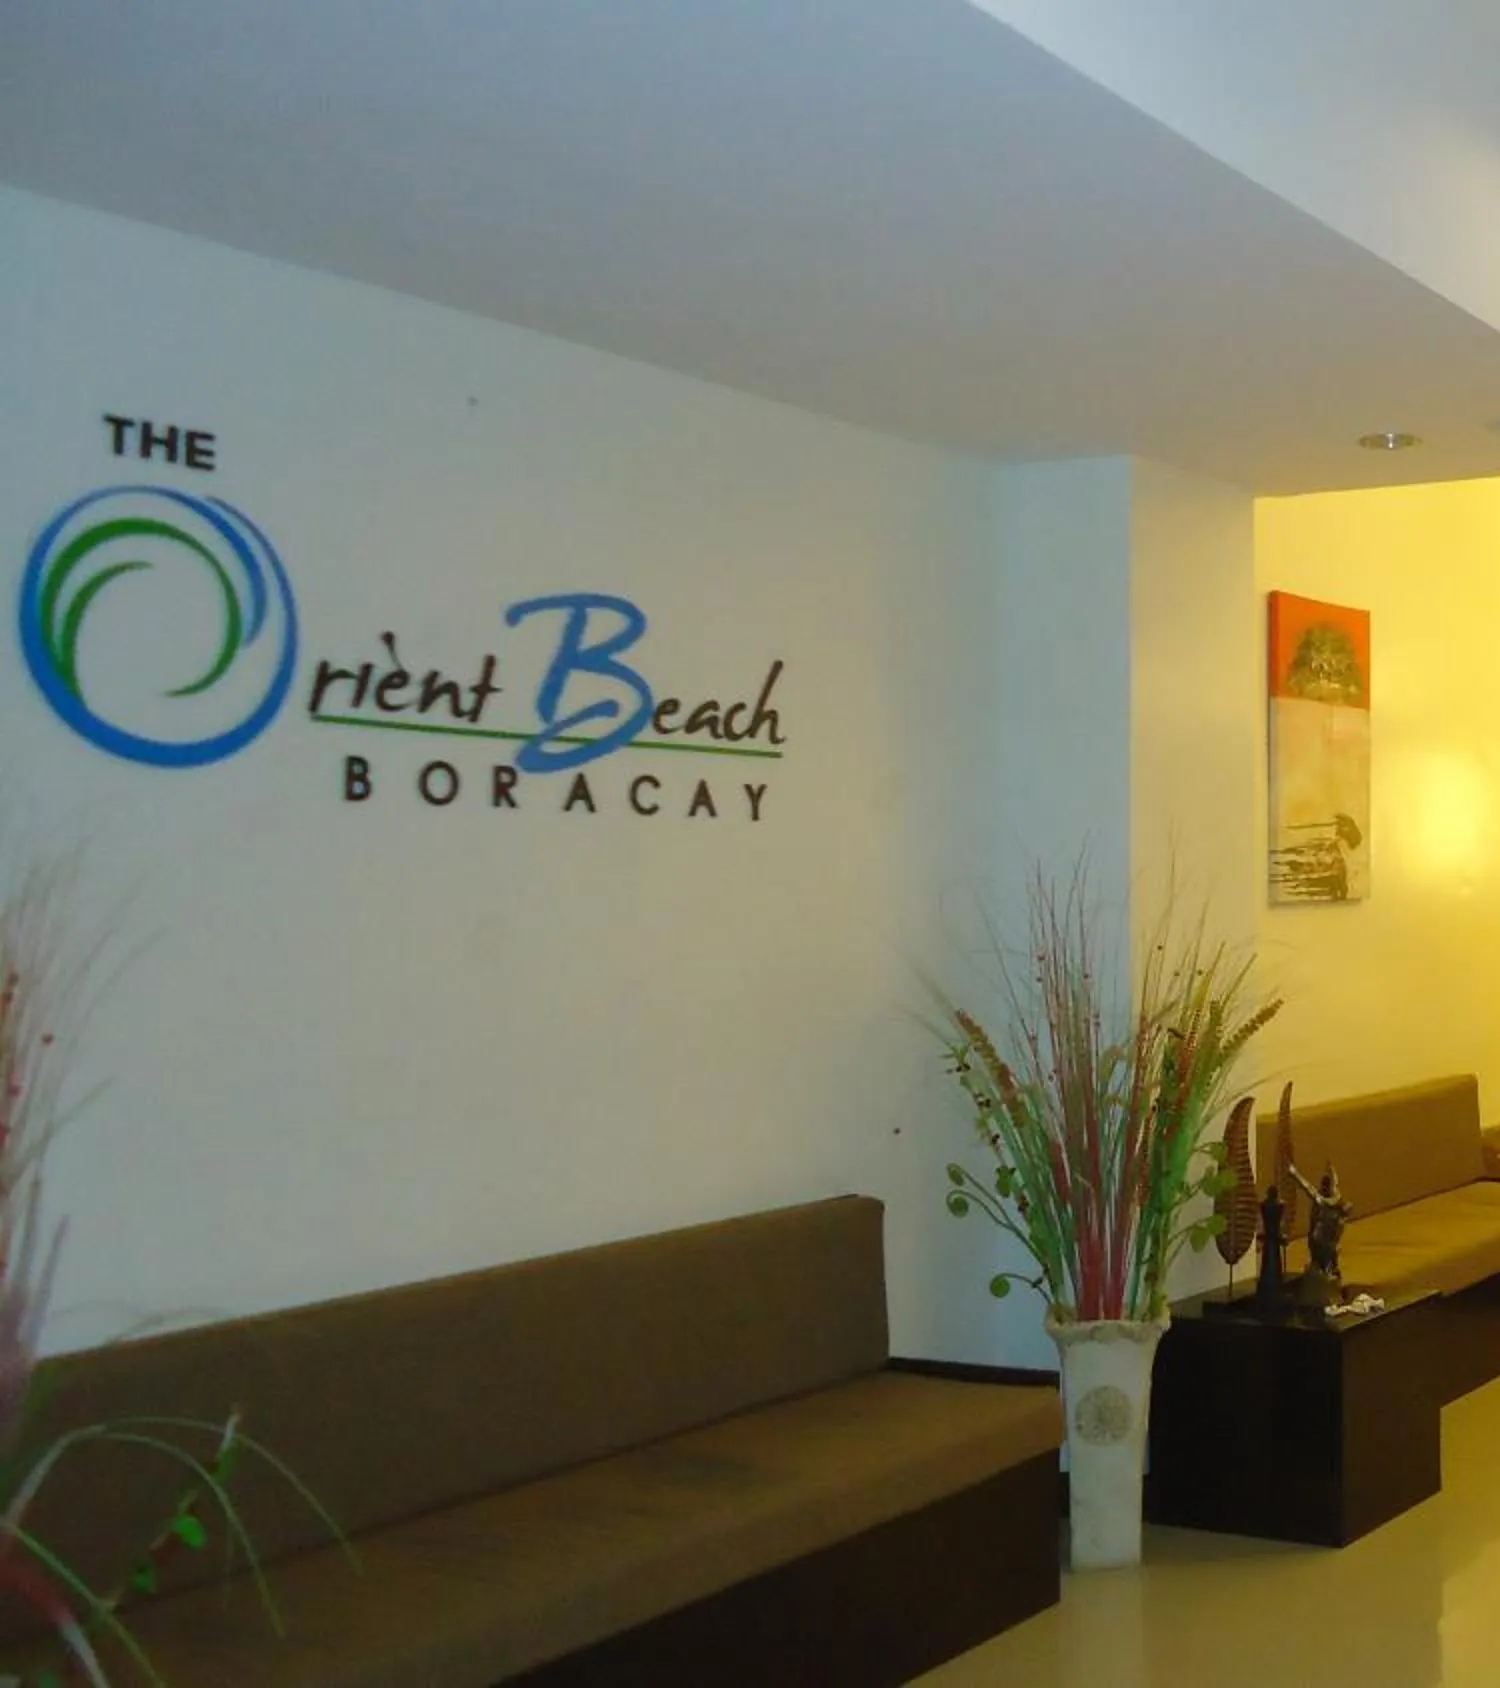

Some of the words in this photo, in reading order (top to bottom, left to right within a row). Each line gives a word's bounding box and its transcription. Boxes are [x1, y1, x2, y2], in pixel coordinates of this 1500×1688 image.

[103, 414, 217, 471] THE
[505, 592, 785, 772] Beach
[343, 756, 768, 822] BORACAY
